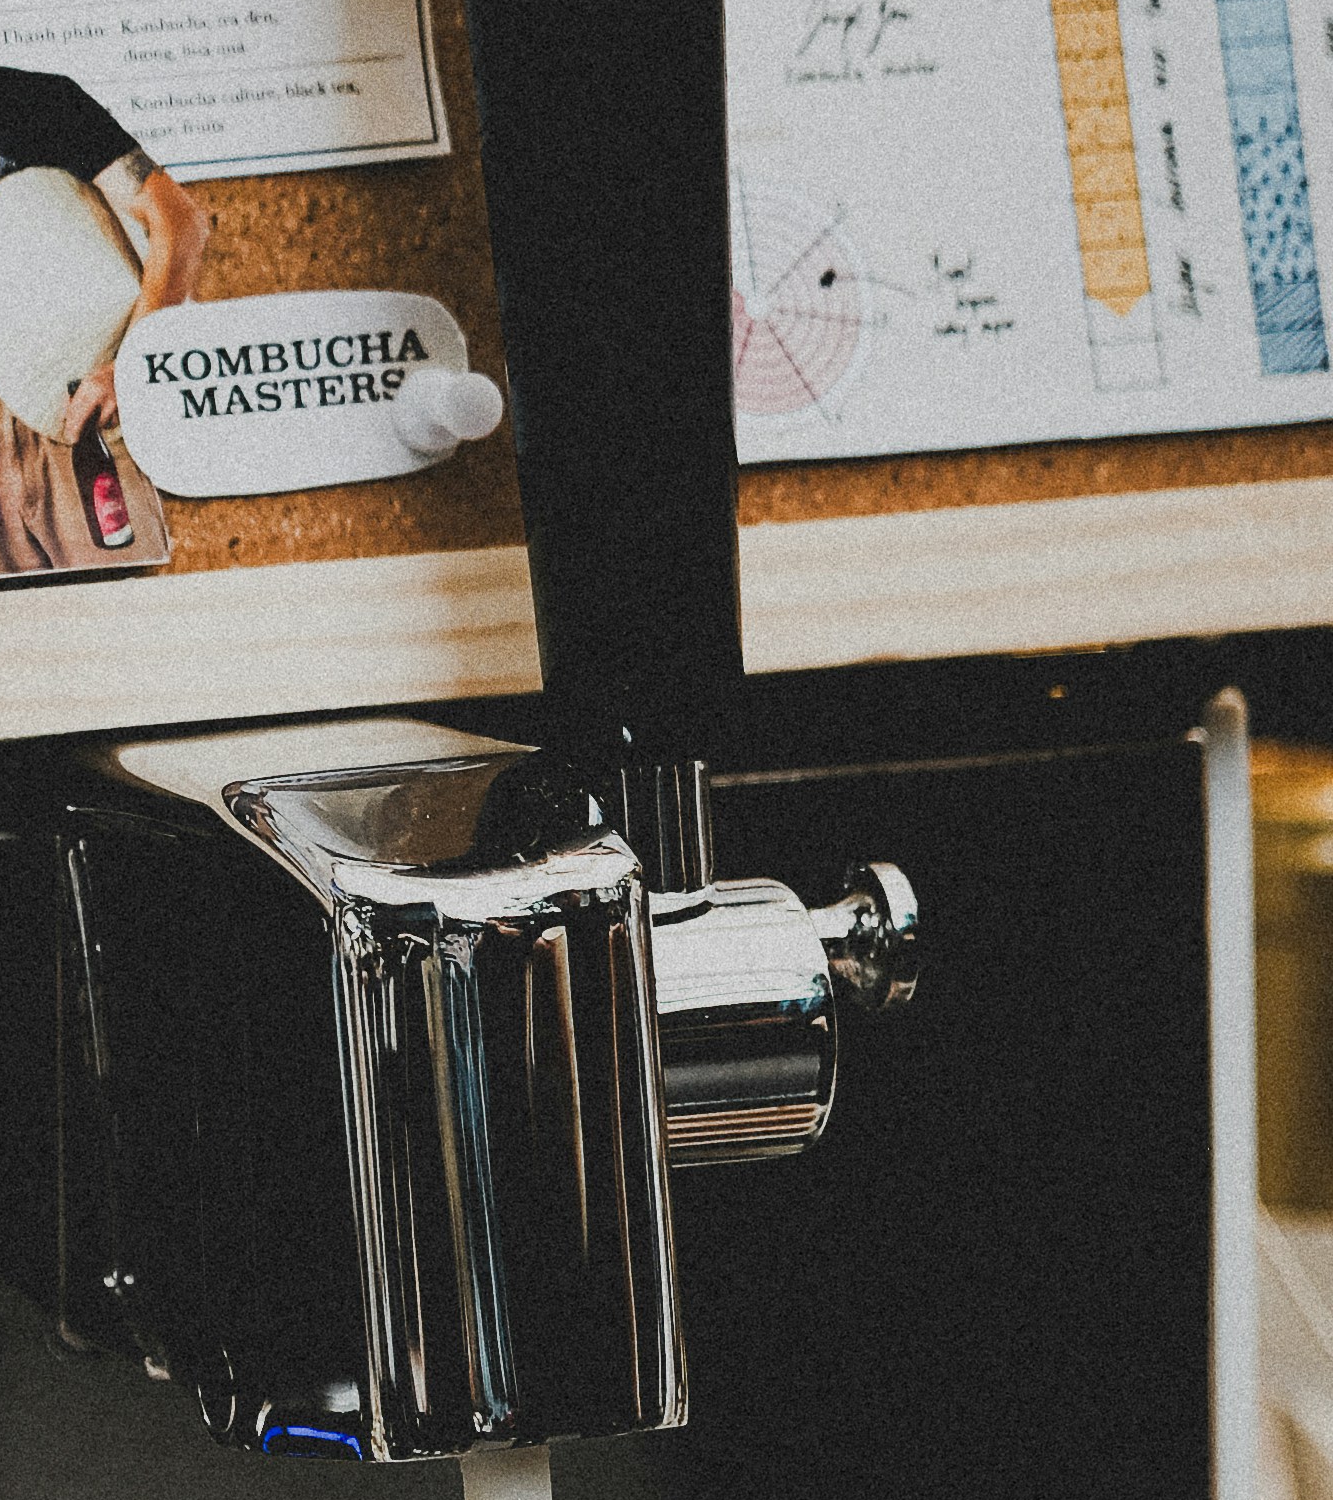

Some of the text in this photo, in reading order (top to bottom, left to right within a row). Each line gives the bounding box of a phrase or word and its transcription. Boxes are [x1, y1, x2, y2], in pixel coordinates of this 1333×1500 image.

[130, 91, 218, 111] Kombucha
[285, 80, 327, 99] black
[331, 80, 363, 98] tea,
[144, 328, 429, 385] KOMBUCHA
[180, 369, 405, 420] MASTERS
